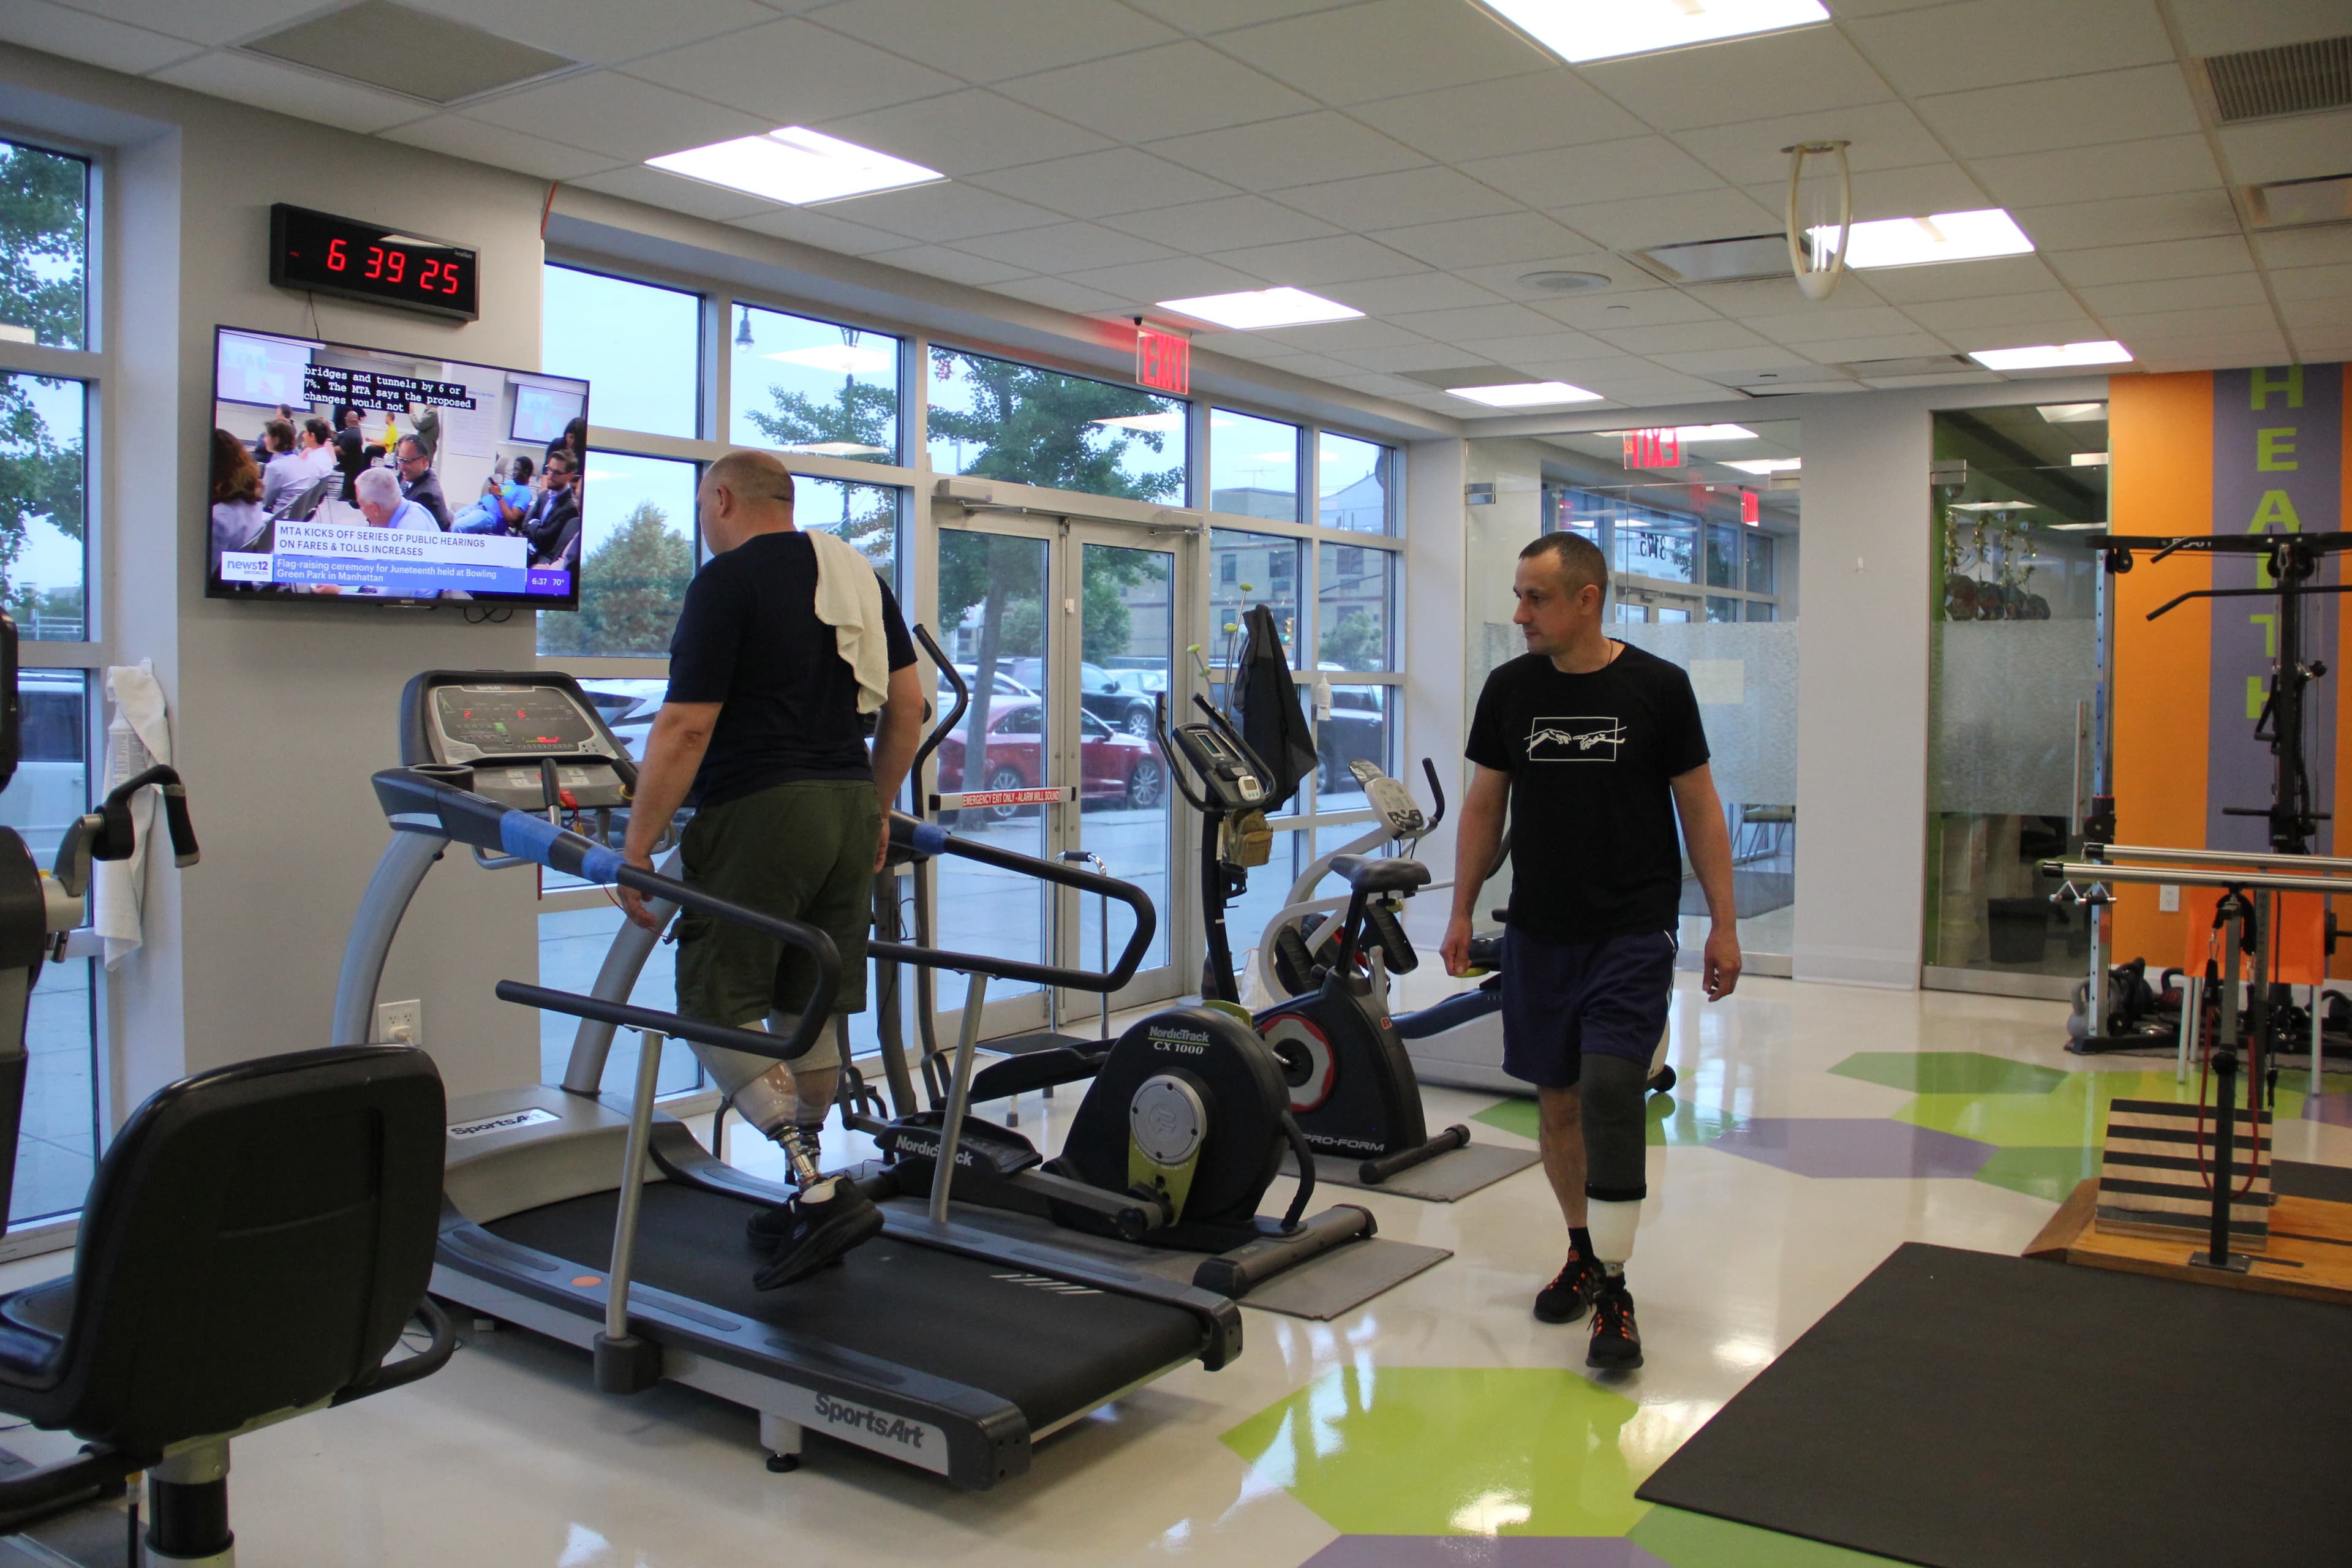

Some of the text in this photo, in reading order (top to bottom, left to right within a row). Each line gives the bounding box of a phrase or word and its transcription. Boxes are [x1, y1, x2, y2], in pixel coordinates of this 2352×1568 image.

[327, 238, 459, 294] 6 39 25
[1143, 334, 1186, 391] EXIT
[305, 366, 347, 380] bridges
[353, 374, 371, 383] and
[377, 376, 417, 389] tunnels
[421, 381, 434, 393] by
[304, 391, 404, 412] changes would not
[305, 378, 471, 409] 7%. The MTA says the proposed
[280, 526, 485, 548] MTA KICKS OFF SERIES OF PUBLIC HEARINGS
[279, 540, 295, 548] ON
[298, 541, 328, 551] FARES
[340, 543, 369, 552] TOLLS
[372, 545, 423, 556] INCREASES
[227, 560, 268, 570] news12
[277, 558, 330, 571] Flag-raising
[331, 564, 374, 573] ceremony
[376, 563, 388, 573] for
[390, 564, 435, 576] Juneteenth
[438, 567, 455, 576] held
[466, 568, 497, 579] Bowling
[277, 569, 383, 582] Green Park in Manhattan
[532, 577, 547, 586] 6:37
[963, 794, 992, 805] EMERGENCY
[992, 793, 1002, 803] EXIT
[1003, 793, 1015, 802] ONLY
[1018, 791, 1033, 802] ALARM
[1034, 790, 1044, 801] WILL
[1045, 790, 1060, 801] SOUND
[1150, 1026, 1210, 1042] NordicTrack
[1154, 1041, 1204, 1054] CX 1000
[895, 1134, 973, 1166] Nordicck
[1303, 1134, 1384, 1152] PRO-FORM
[815, 1391, 924, 1448] SportsArt
